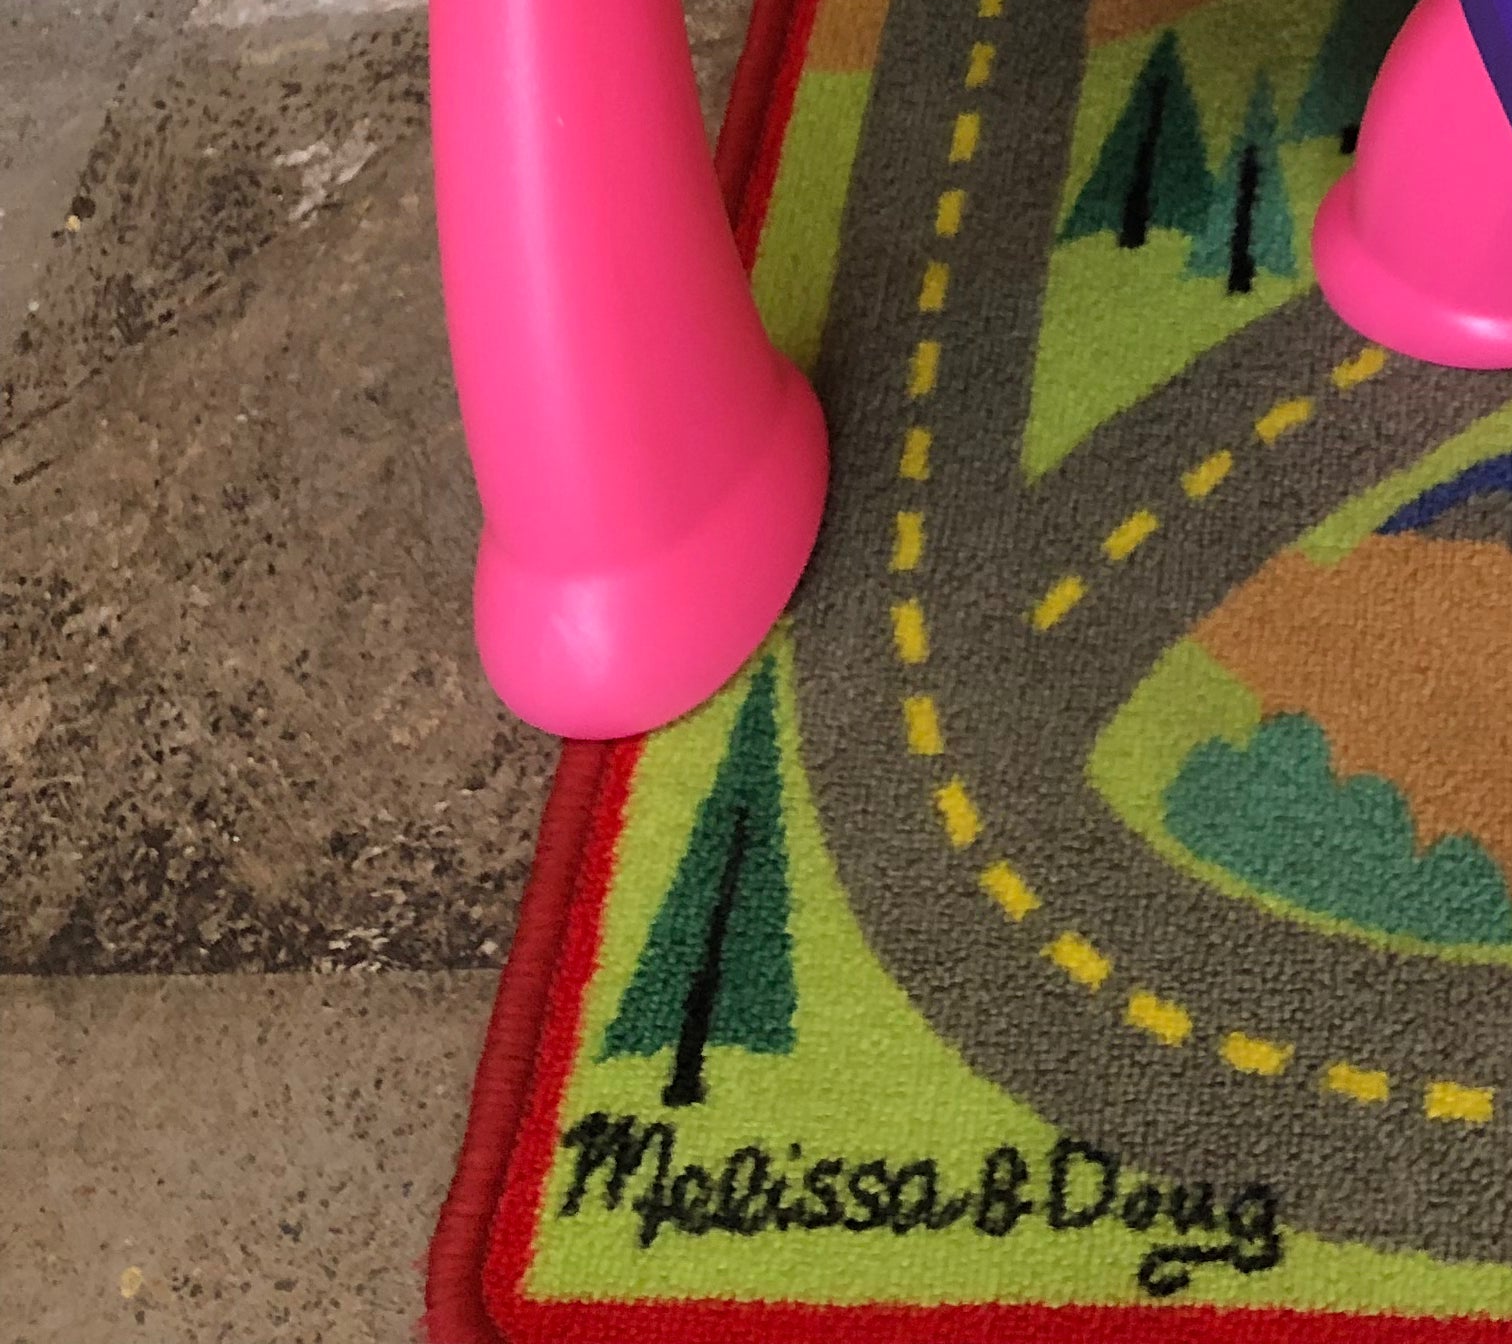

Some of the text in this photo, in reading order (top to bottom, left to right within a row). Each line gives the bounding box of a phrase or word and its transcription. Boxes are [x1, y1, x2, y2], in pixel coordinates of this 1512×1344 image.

[560, 1112, 1283, 1296] Melissa & Doug
